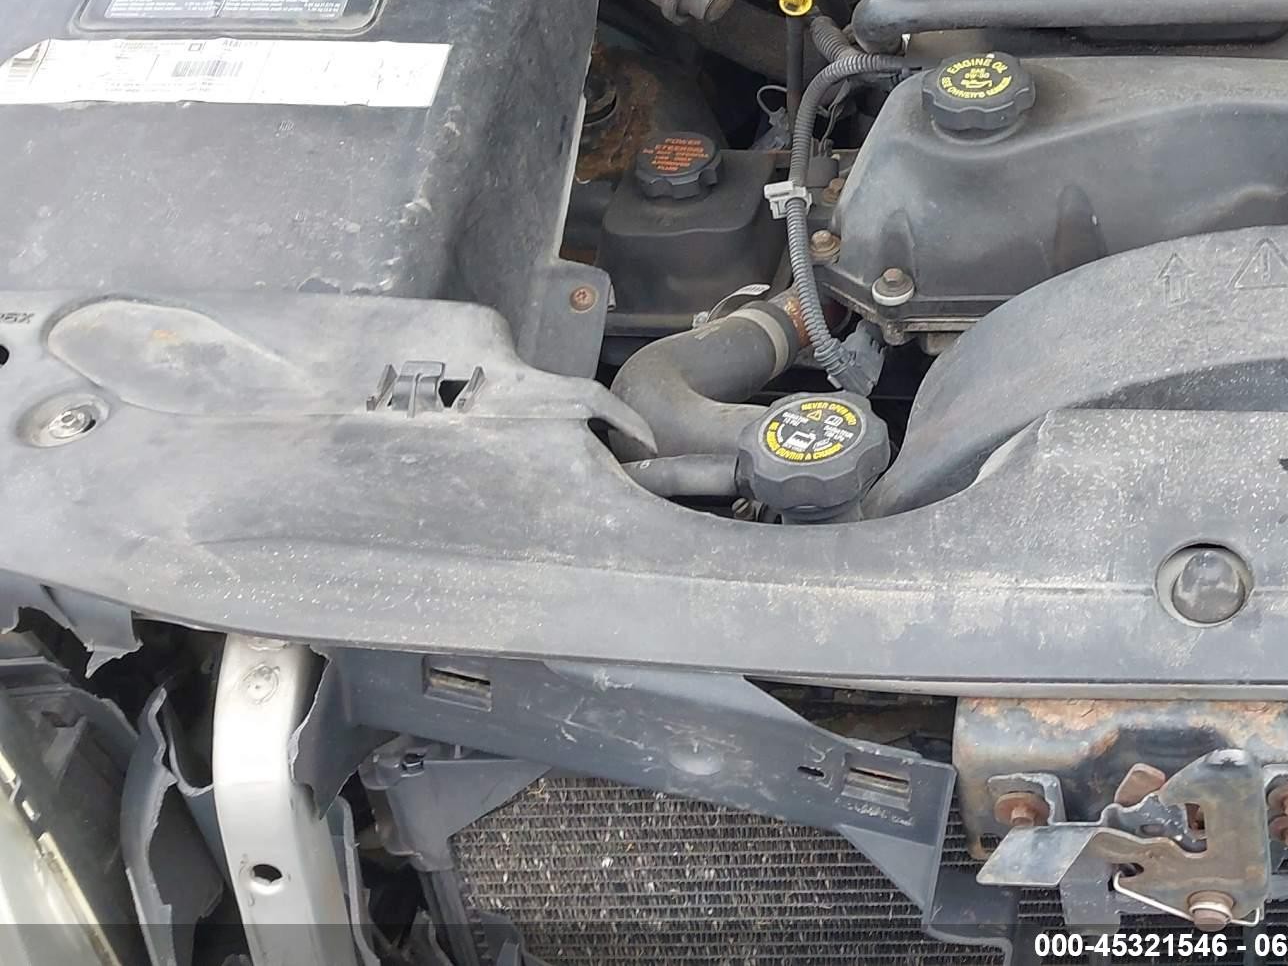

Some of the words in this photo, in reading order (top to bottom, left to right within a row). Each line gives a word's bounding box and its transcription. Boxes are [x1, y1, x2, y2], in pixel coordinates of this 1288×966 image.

[947, 58, 993, 74] ENGINE
[992, 61, 1008, 74] OIL
[801, 401, 829, 411] NEVER
[828, 402, 849, 416] OPEN
